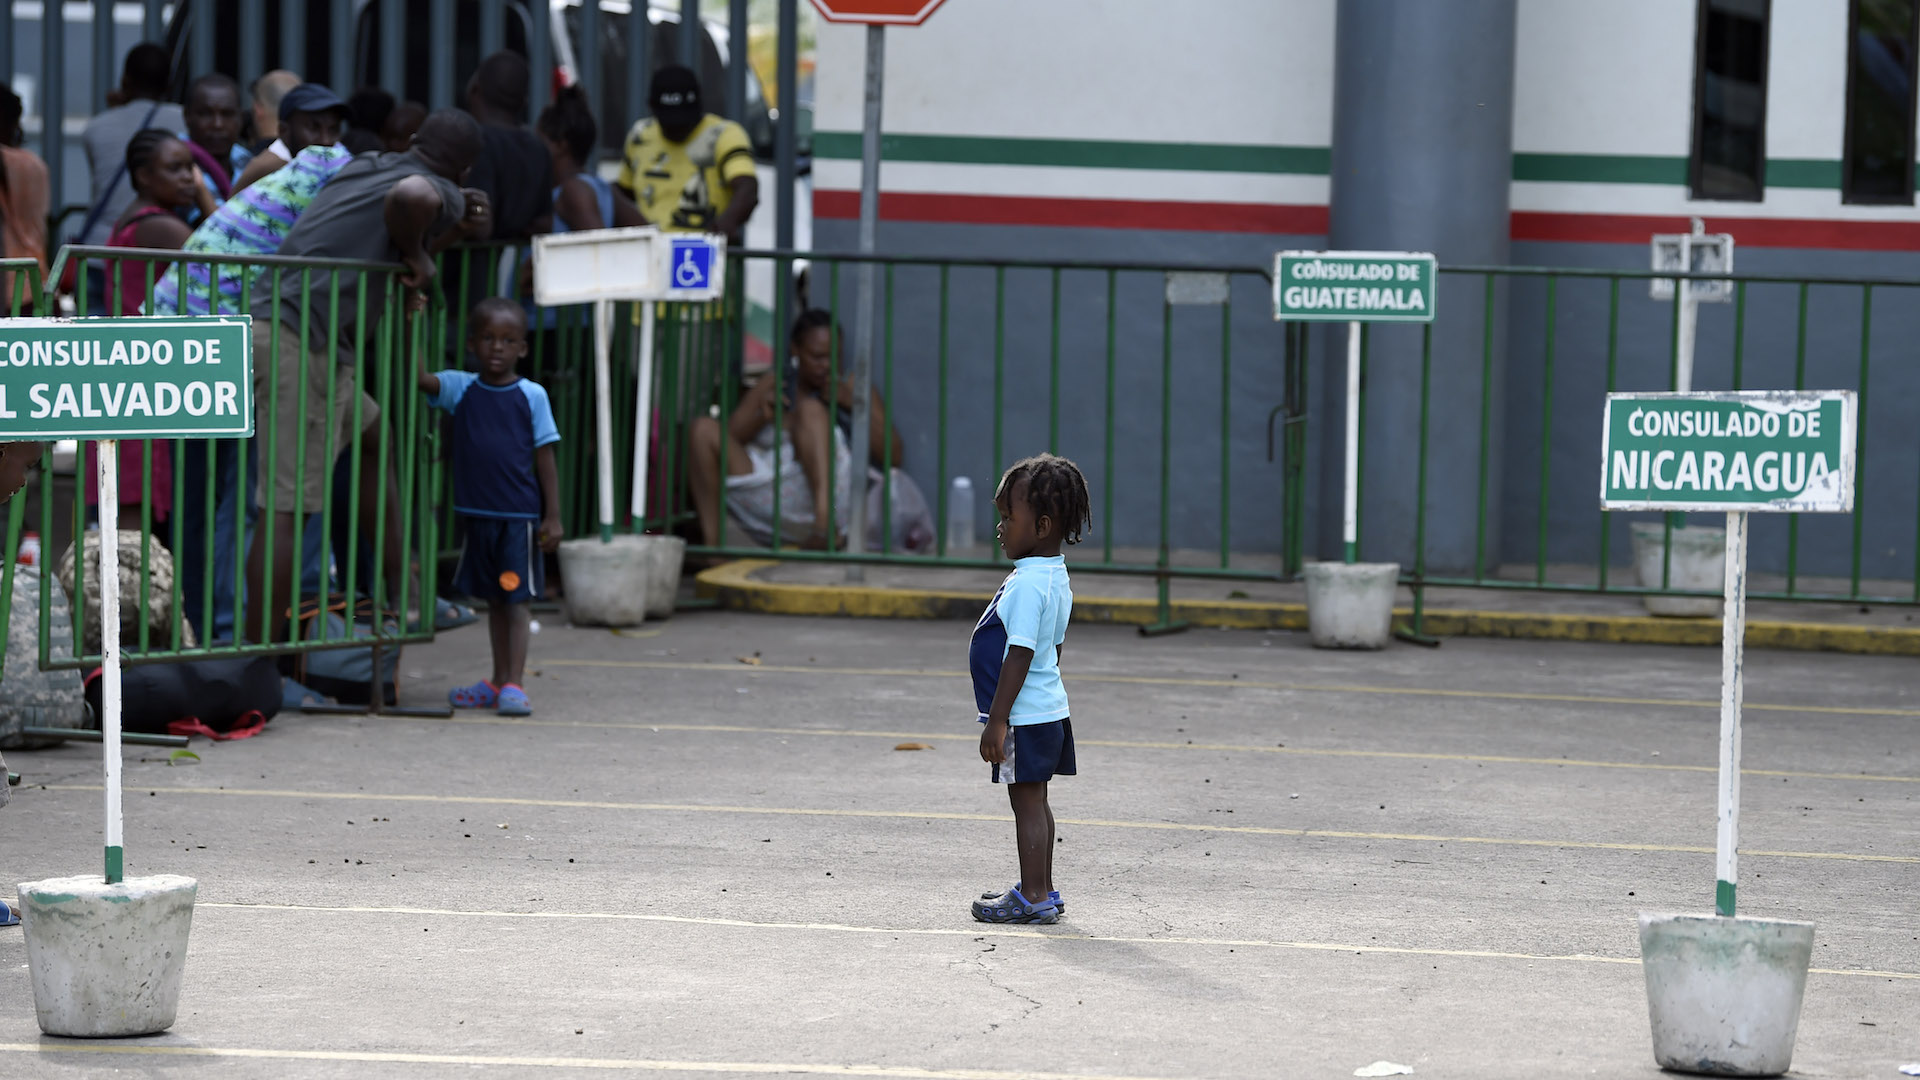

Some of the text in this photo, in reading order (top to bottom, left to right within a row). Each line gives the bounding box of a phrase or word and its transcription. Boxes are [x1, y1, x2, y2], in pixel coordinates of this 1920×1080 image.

[1291, 262, 1420, 281] CONSULADO DE
[1284, 286, 1425, 310] GUATEMALA
[183, 339, 221, 365] DE
[29, 381, 238, 418] SALVADOR
[1628, 410, 1821, 437] CONSULADO DE
[1612, 450, 1834, 492] NICARAGUA
